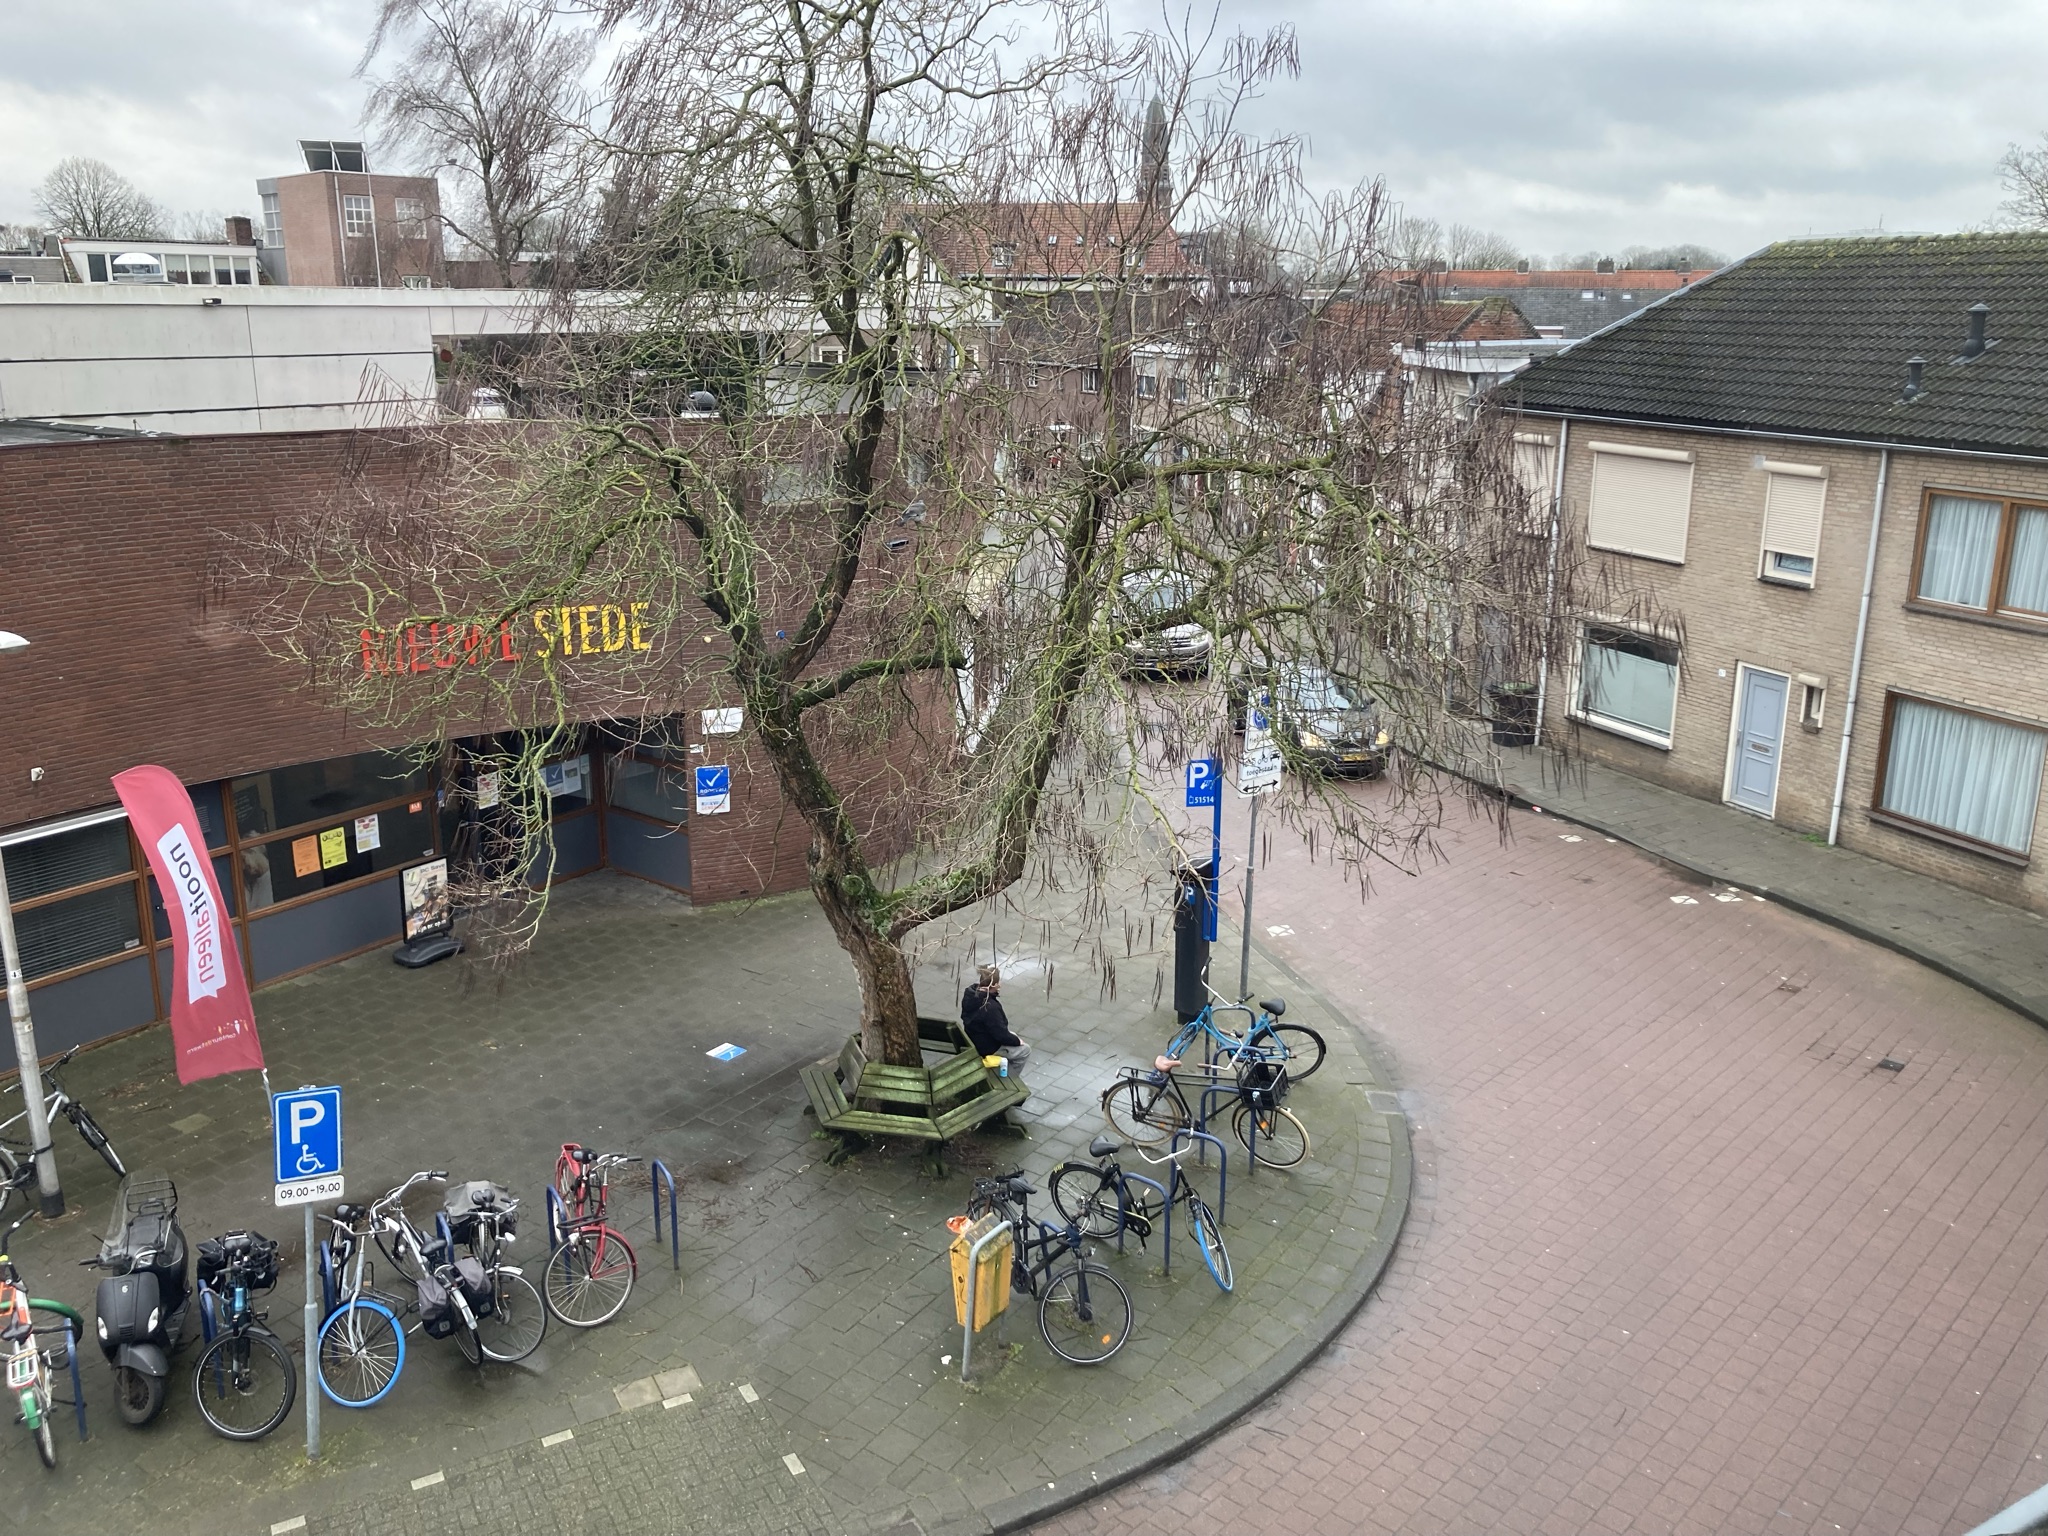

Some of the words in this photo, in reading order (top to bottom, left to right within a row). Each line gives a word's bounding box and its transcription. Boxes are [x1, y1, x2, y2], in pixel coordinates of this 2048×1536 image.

[360, 612, 522, 680] NIEUWE
[533, 602, 651, 658] STEDE
[1189, 762, 1209, 788] P
[1194, 795, 1214, 804] 51514
[1184, 886, 1194, 900] P
[290, 1099, 325, 1145] P
[280, 1182, 341, 1199] 09.00-19.00
